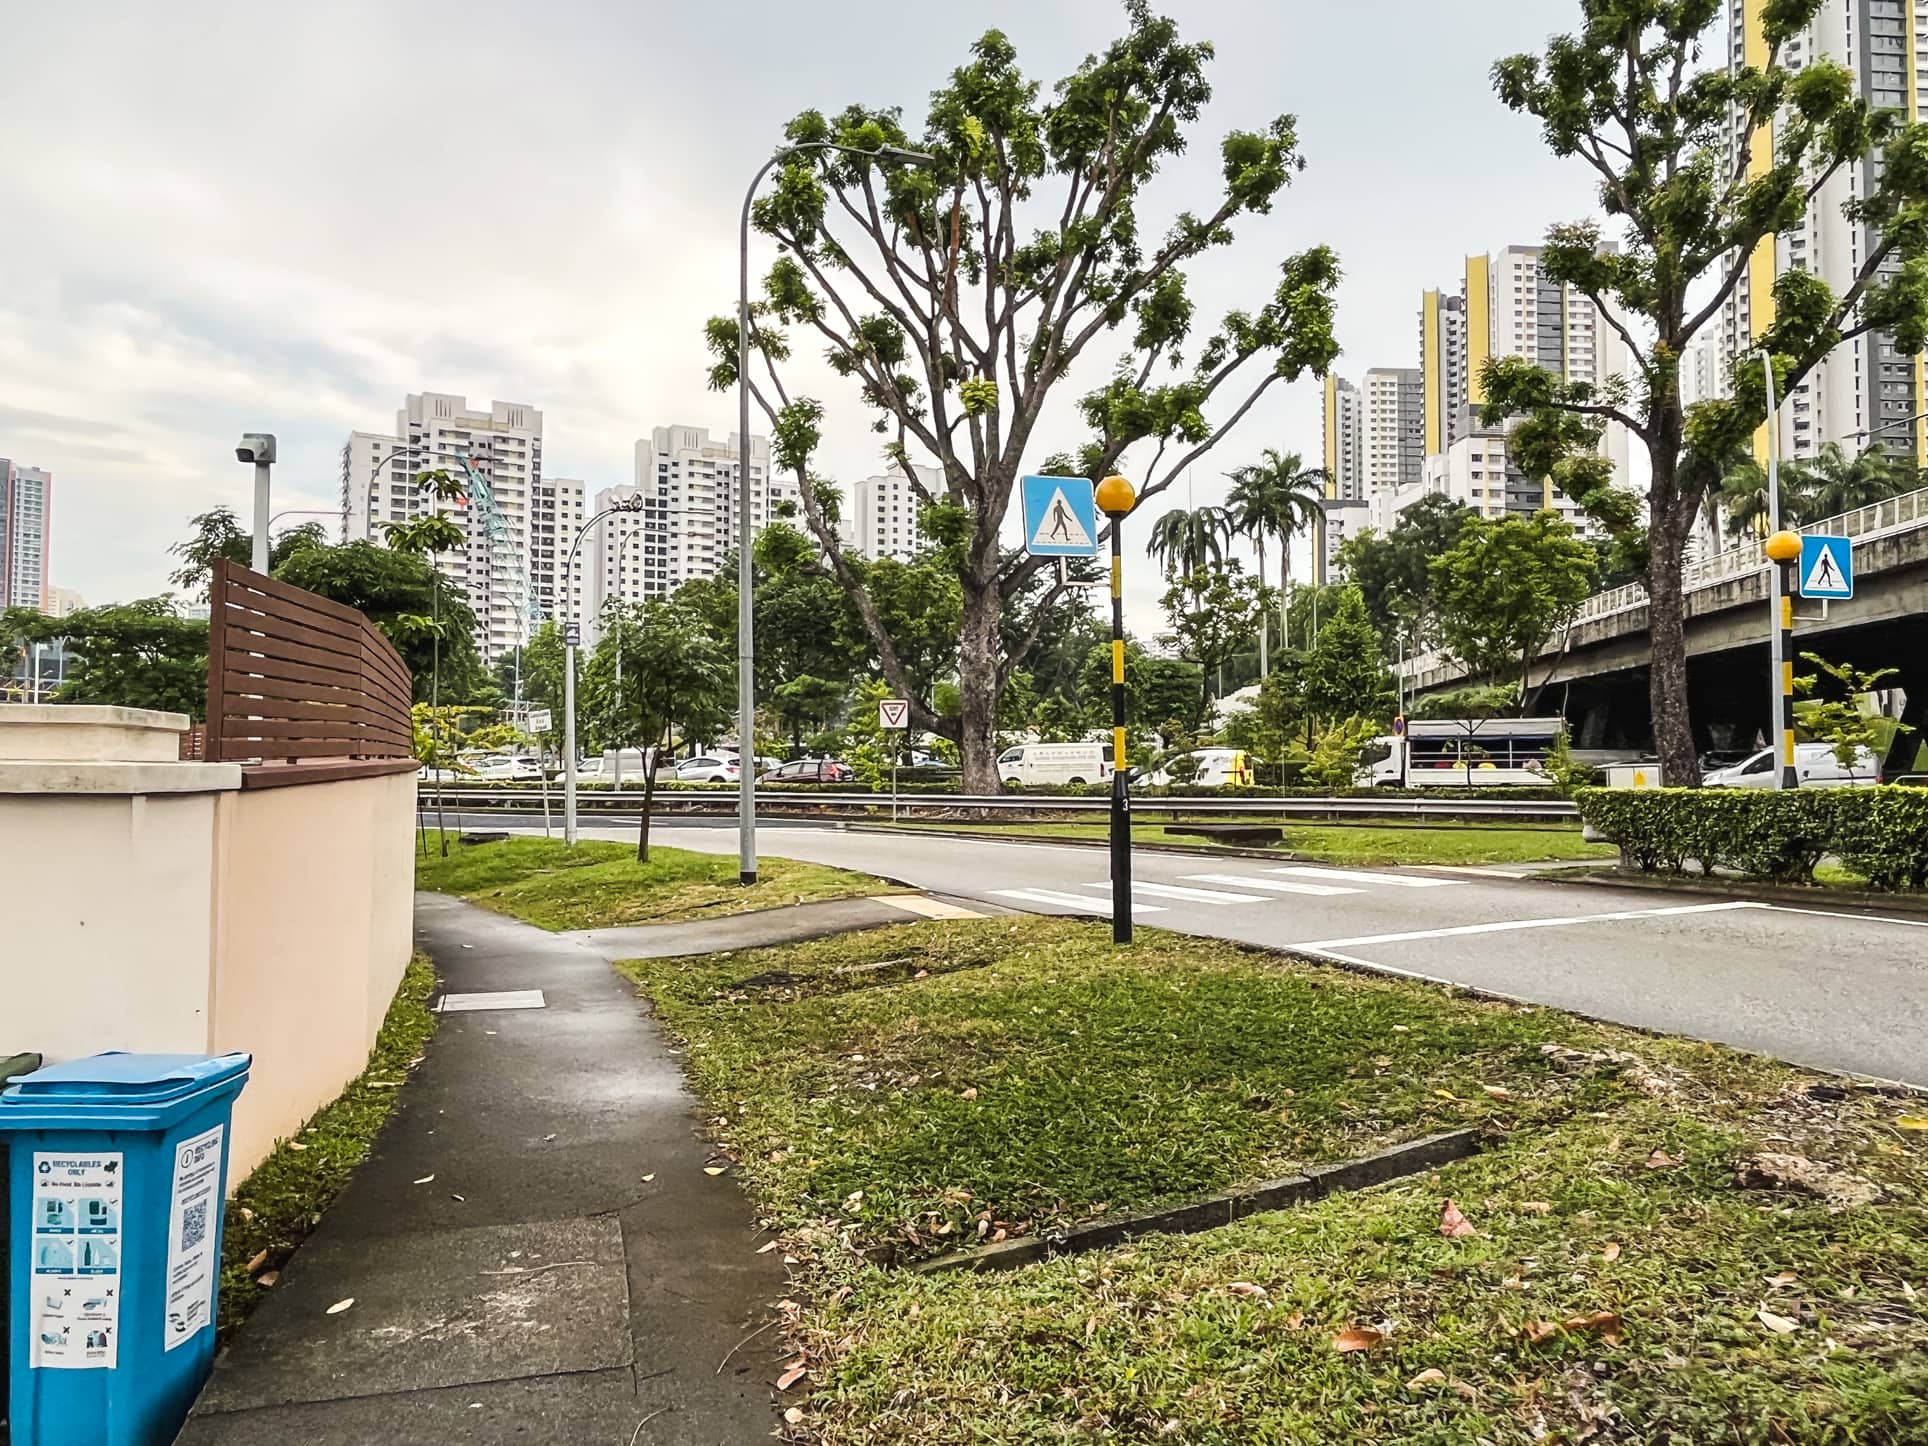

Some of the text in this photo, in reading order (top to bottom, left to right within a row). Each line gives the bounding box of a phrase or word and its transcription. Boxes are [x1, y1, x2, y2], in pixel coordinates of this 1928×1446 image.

[1122, 798, 1129, 811] 3
[53, 1160, 102, 1168] RECYCLABLES
[67, 1168, 85, 1176] ONLY
